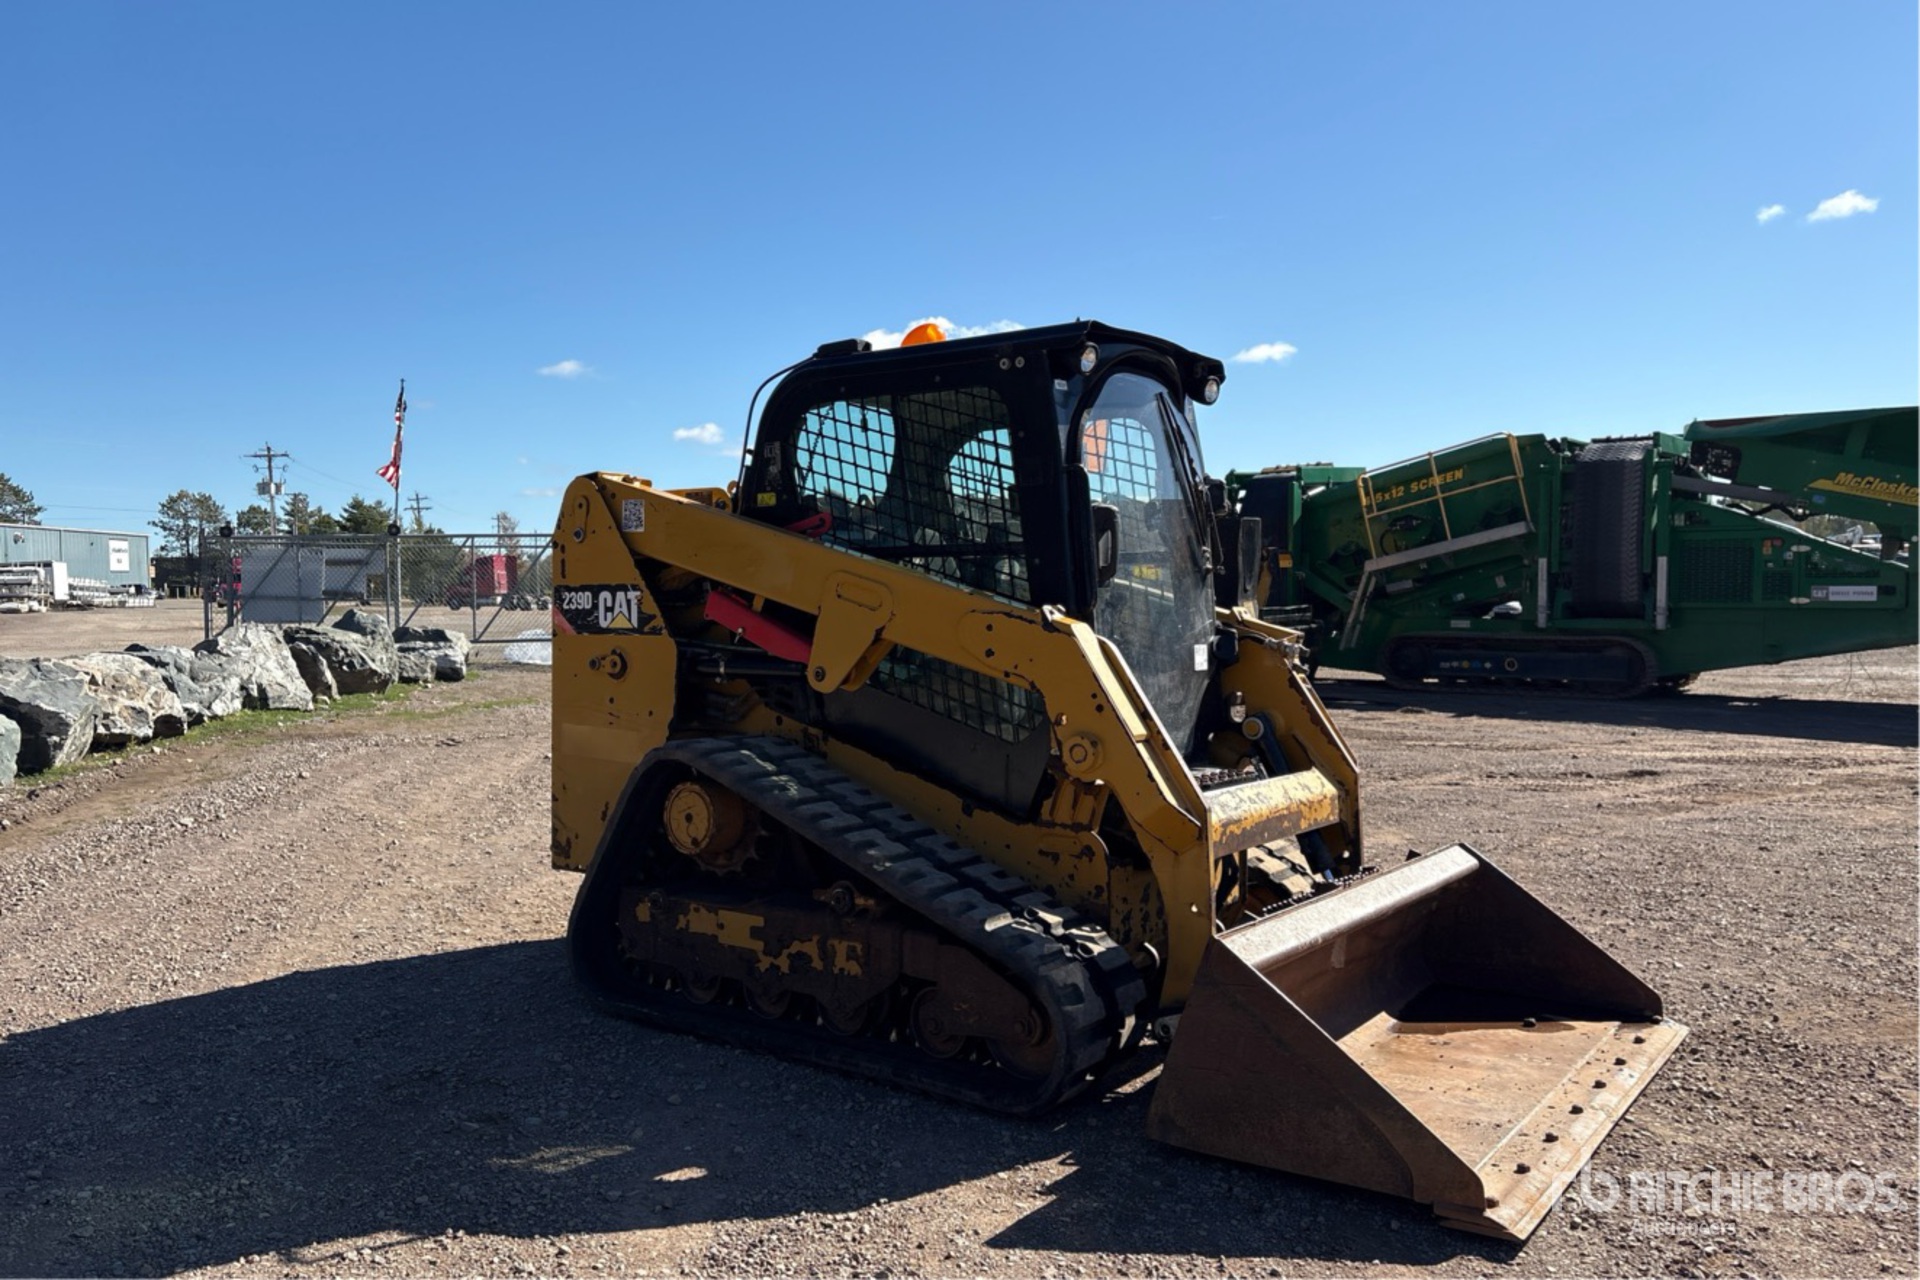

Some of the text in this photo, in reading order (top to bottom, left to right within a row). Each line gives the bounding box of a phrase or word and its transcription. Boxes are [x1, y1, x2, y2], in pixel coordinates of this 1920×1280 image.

[1410, 468, 1464, 493] SCREEN
[562, 590, 641, 629] 239D CAT
